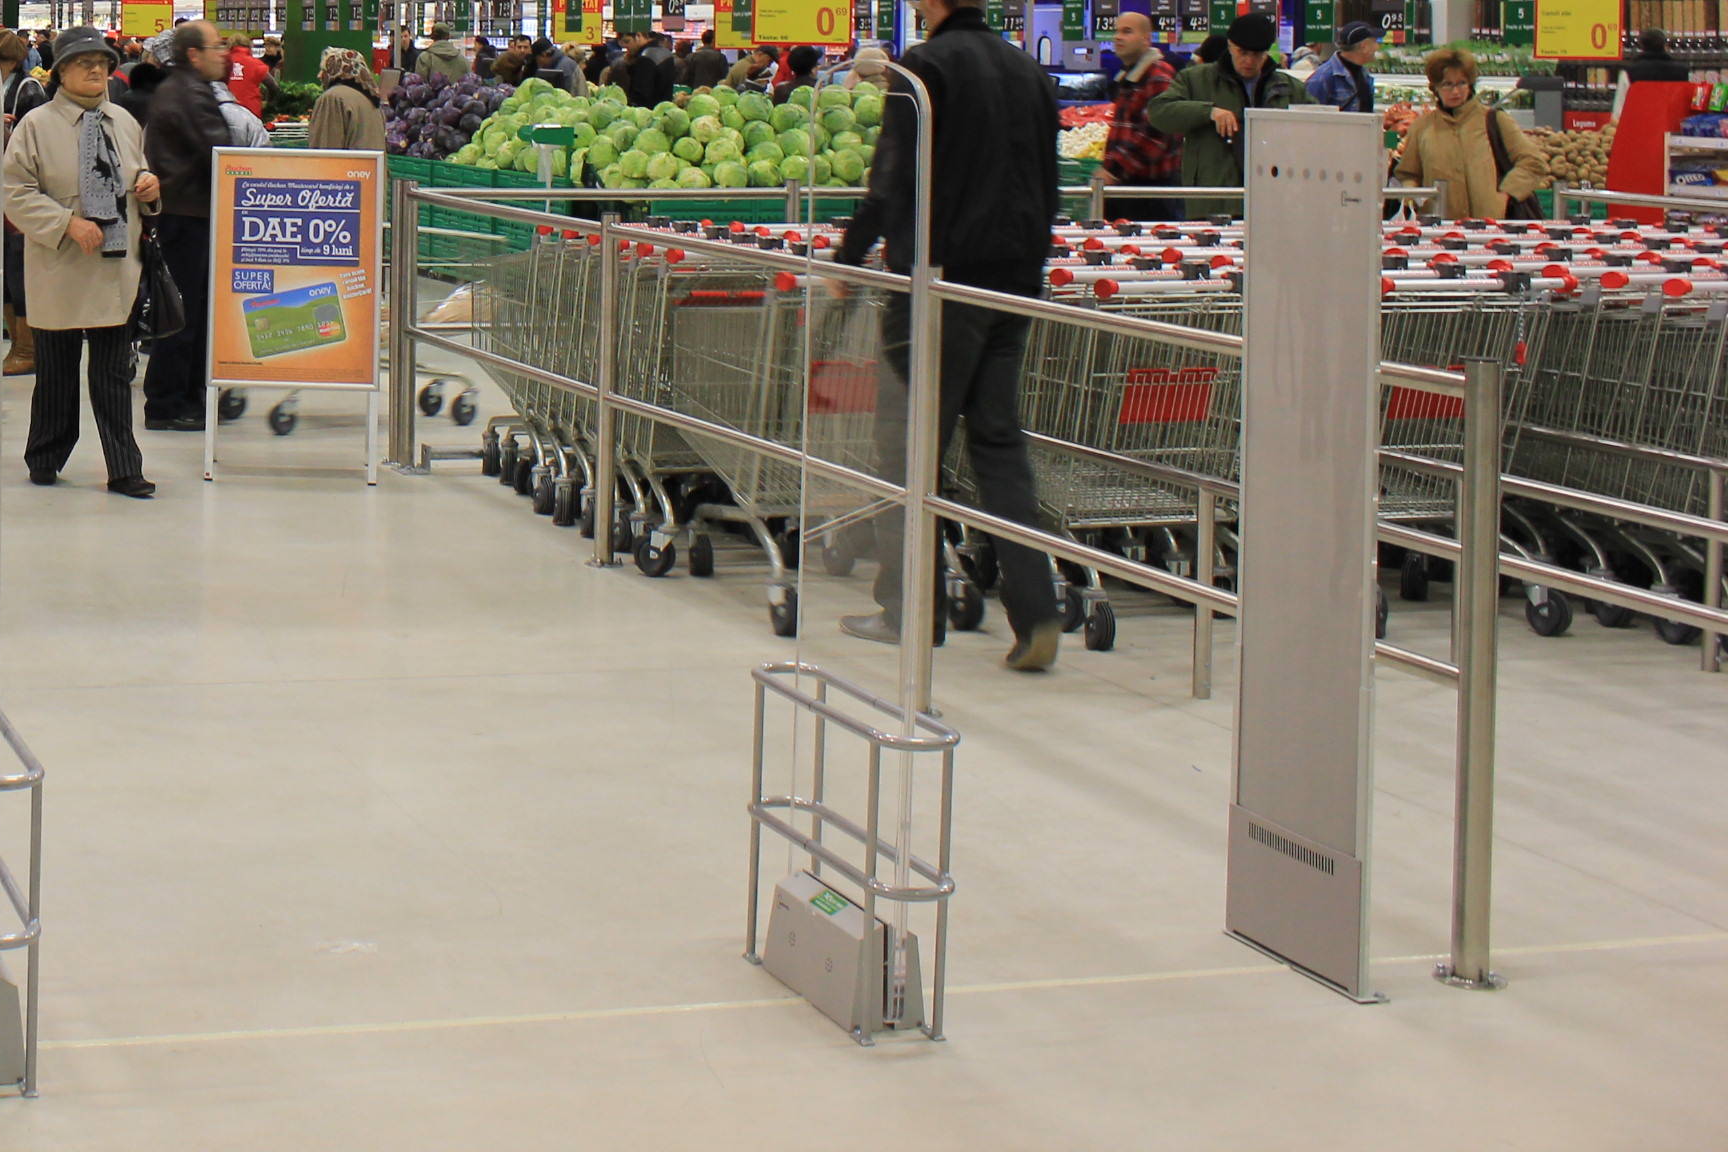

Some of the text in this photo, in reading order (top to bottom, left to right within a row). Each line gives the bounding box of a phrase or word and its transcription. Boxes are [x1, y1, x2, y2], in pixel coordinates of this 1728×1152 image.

[816, 7, 835, 36] 0
[1591, 23, 1608, 50] 0
[347, 170, 370, 179] oney
[241, 188, 353, 210] Super Ofertă
[241, 216, 351, 244] DAE 0%
[323, 245, 330, 255] 9
[331, 245, 353, 256] luni
[235, 271, 270, 281] SUPER
